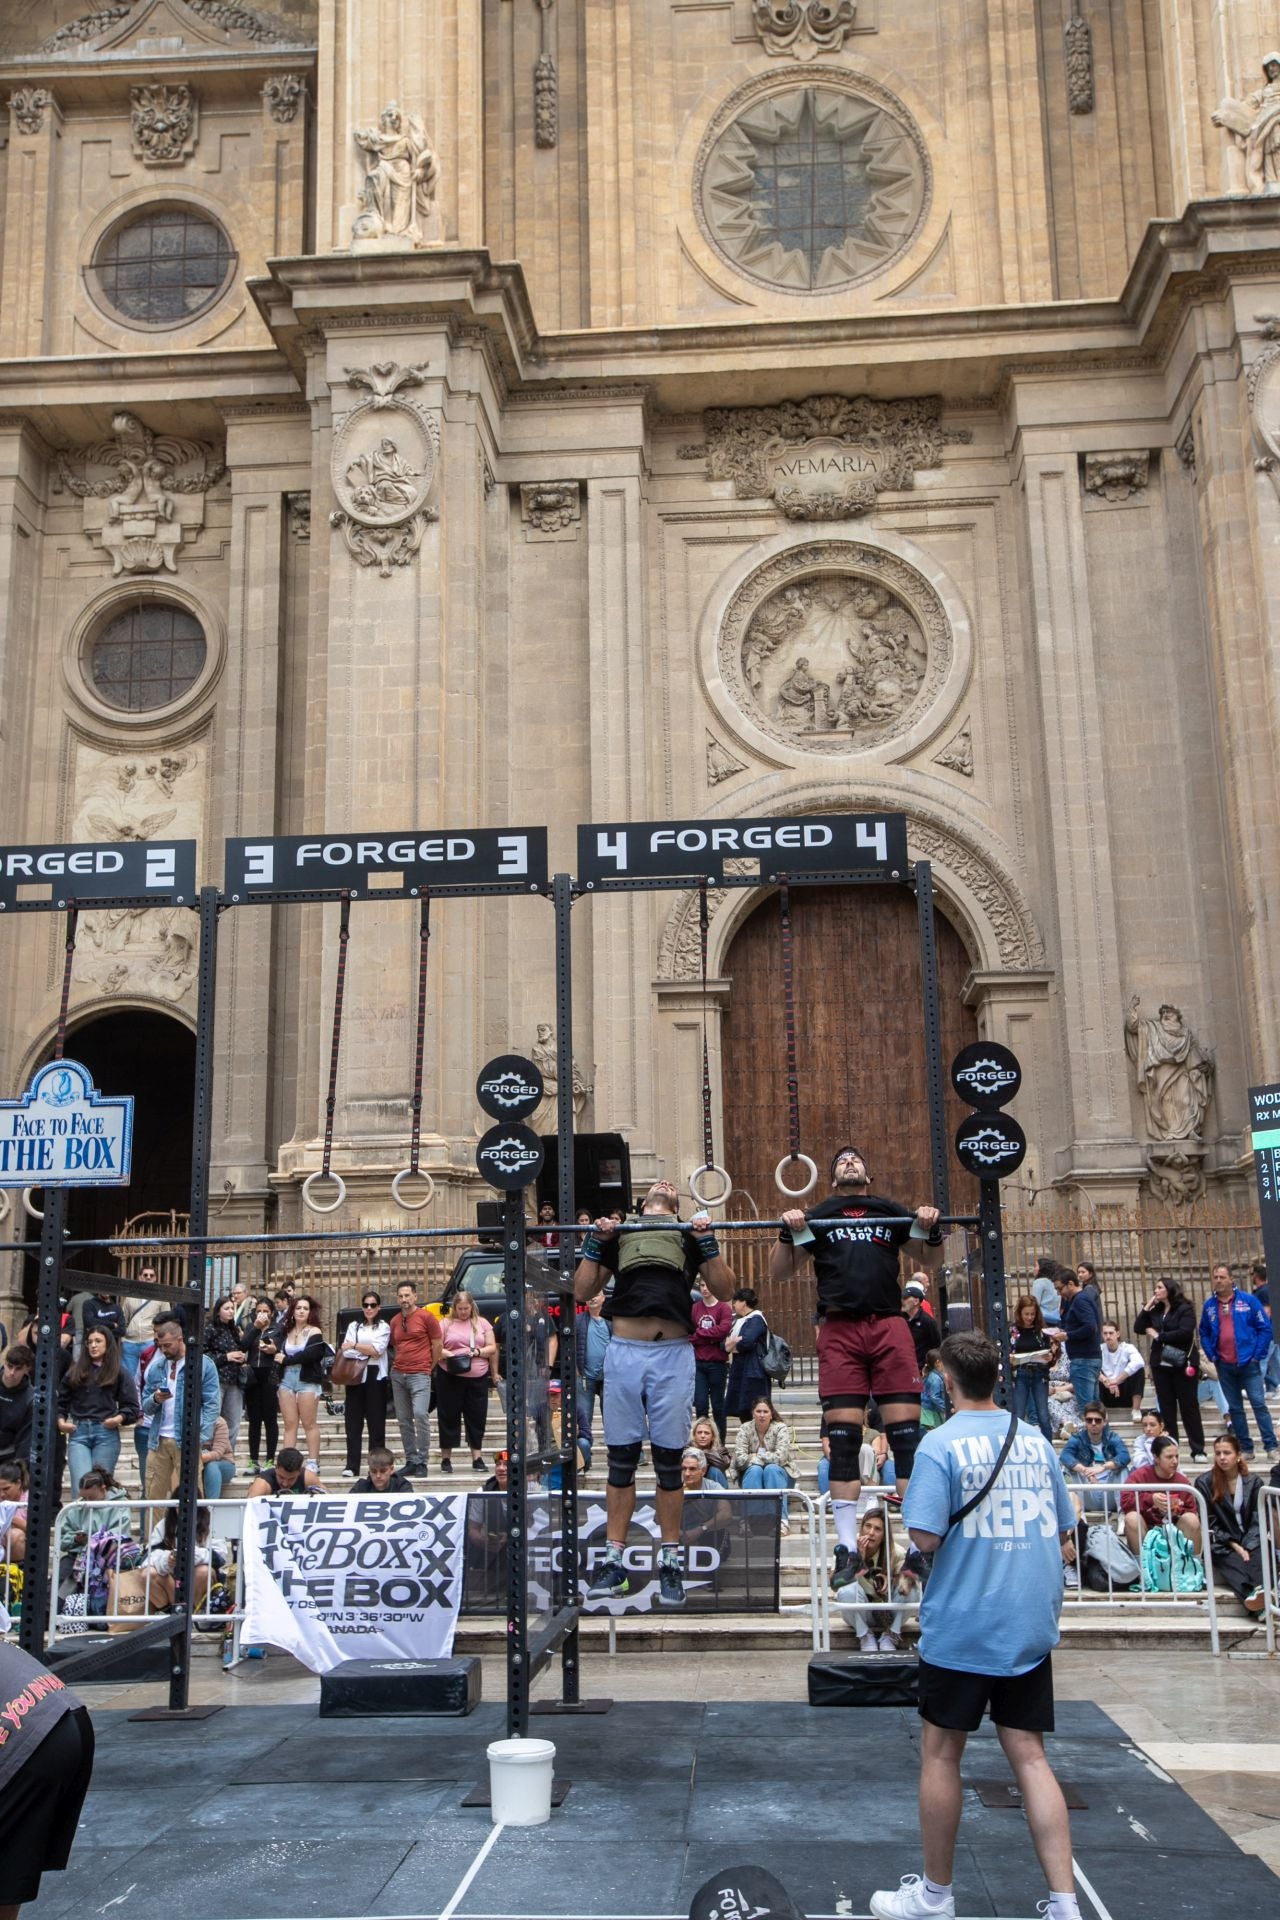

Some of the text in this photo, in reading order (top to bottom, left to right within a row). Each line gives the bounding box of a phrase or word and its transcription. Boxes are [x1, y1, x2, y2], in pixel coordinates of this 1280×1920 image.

[597, 822, 888, 869] 4 FORGED 4
[0, 848, 176, 887] RGED 2
[244, 836, 528, 884] 3 FORGED 3
[956, 1070, 1017, 1082] FORGED
[480, 1084, 539, 1095] FORGED
[1256, 1111, 1270, 1121] RX
[0, 1136, 116, 1172] THE BOX
[480, 1150, 539, 1160] FORGED
[959, 1141, 1020, 1151] FORGED
[1260, 1150, 1266, 1161] 1
[1261, 1163, 1270, 1174] 2
[1262, 1177, 1270, 1188] 3
[1264, 1190, 1272, 1200] 4
[951, 1436, 995, 1466] I'M
[354, 1495, 458, 1523] BOX
[961, 1489, 1058, 1538] REPS
[343, 1578, 454, 1609] BOX
[1, 1688, 37, 1730] YOU
